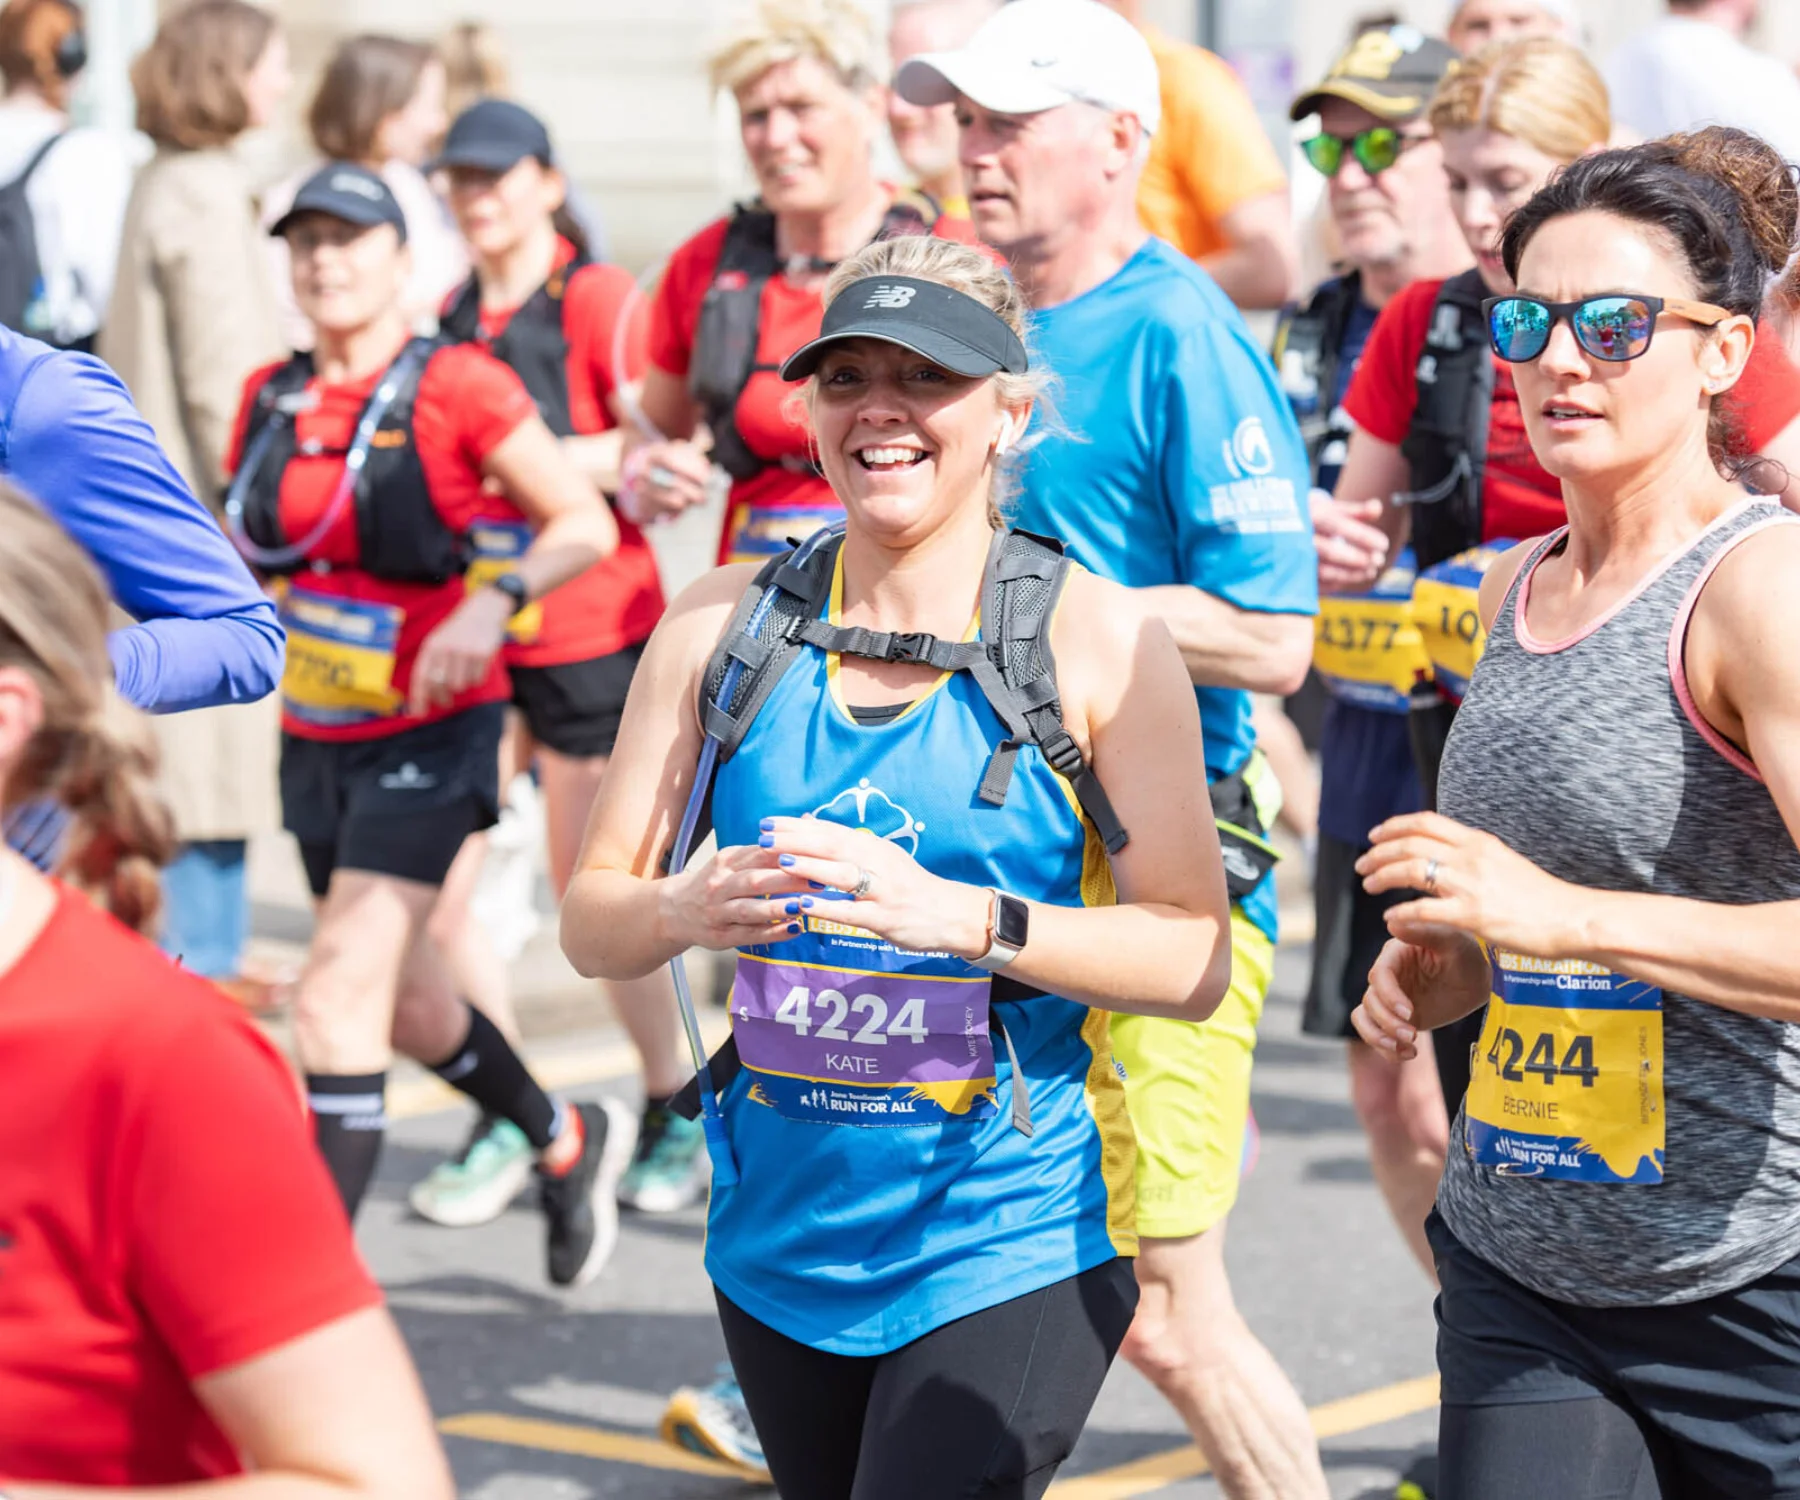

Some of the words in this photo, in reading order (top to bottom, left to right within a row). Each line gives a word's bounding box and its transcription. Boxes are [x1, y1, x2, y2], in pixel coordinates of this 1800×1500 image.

[838, 938, 878, 953] Partnership
[878, 941, 894, 952] with
[1556, 974, 1612, 991] Clarion
[775, 985, 929, 1045] 4224
[825, 1053, 880, 1075] KATE
[1487, 1026, 1599, 1088] 4244
[830, 1099, 858, 1112] RUN
[860, 1101, 888, 1113] FOR
[890, 1101, 916, 1113] ALL
[1503, 1095, 1559, 1120] BERNIE
[1531, 1151, 1556, 1166] FOR
[1558, 1152, 1581, 1168] ALL
